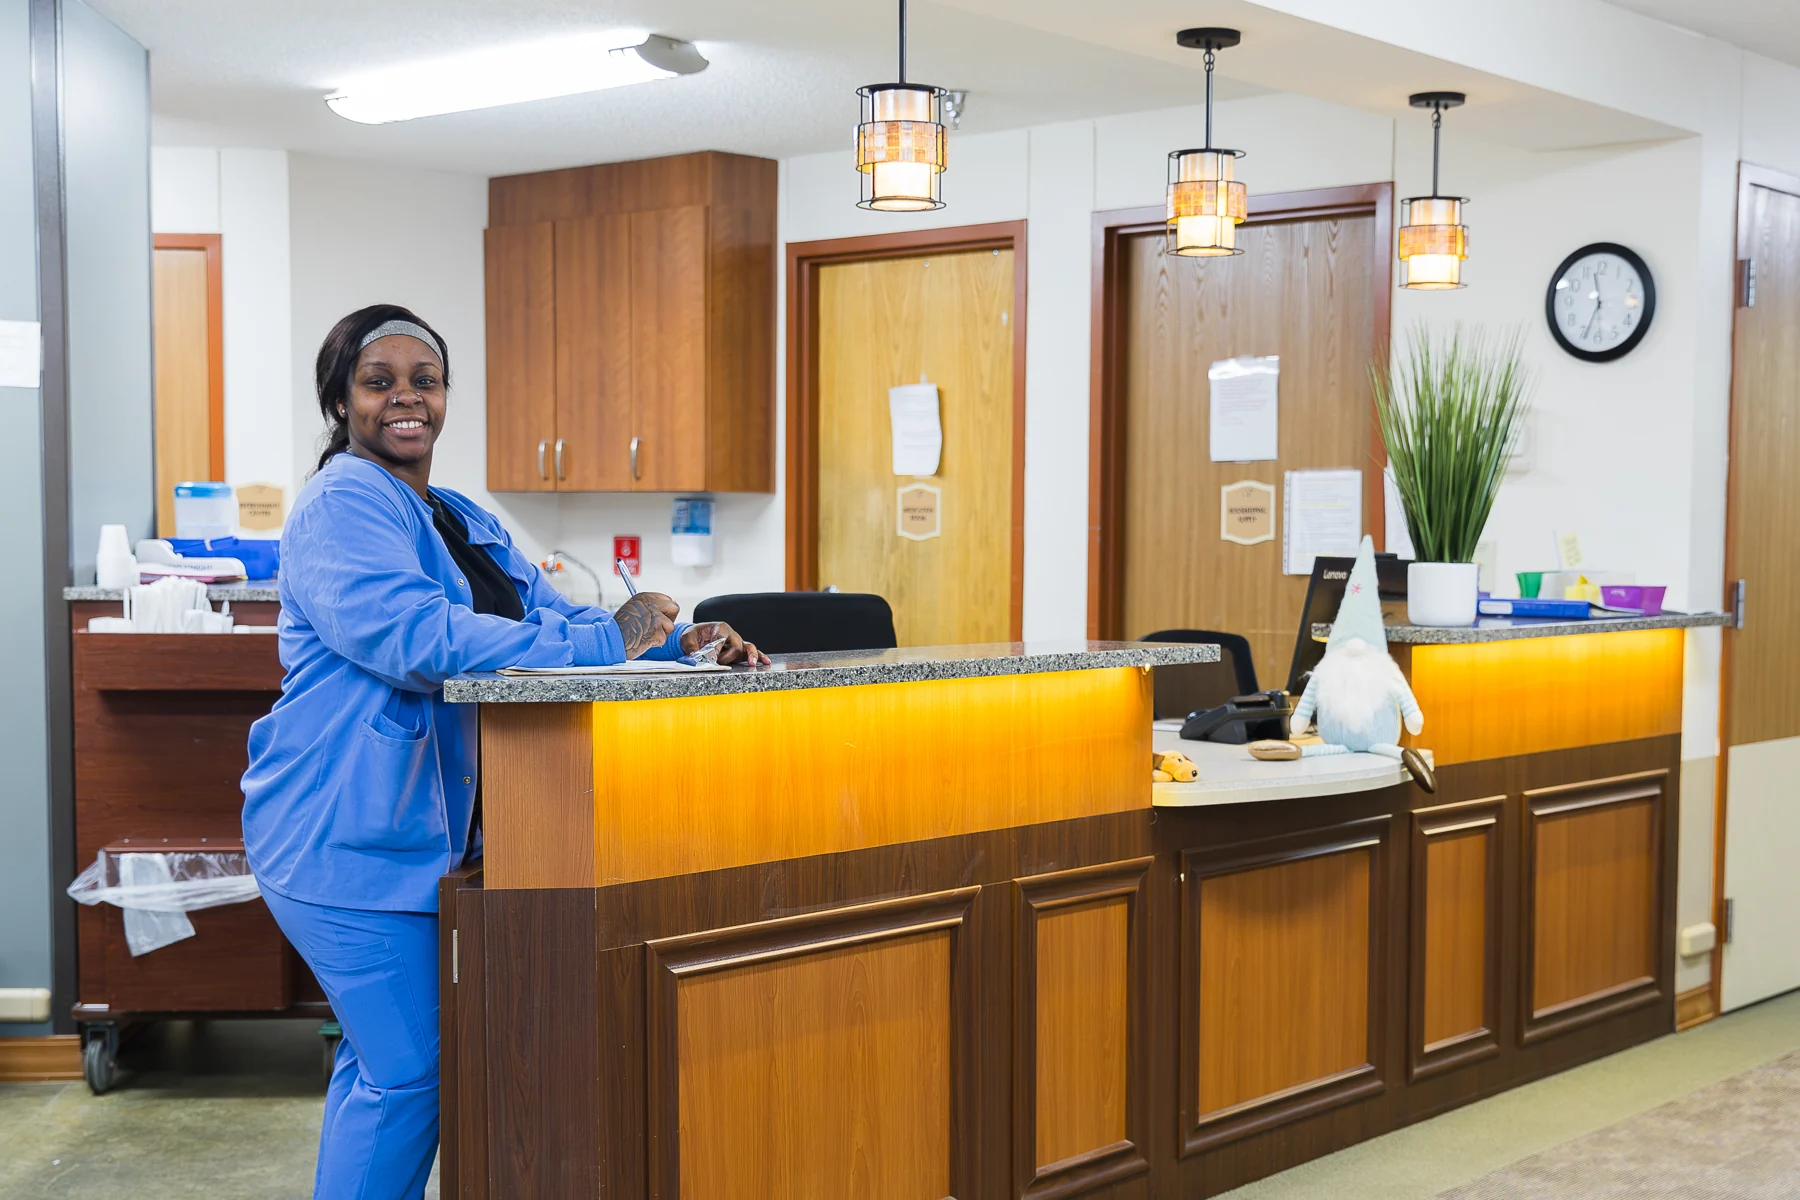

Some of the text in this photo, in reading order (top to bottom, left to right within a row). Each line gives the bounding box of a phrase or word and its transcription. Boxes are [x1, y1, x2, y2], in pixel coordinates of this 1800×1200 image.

[1582, 265, 1590, 280] 11
[1597, 261, 1607, 276] 12
[1568, 277, 1581, 293] 10
[1626, 278, 1633, 293] 2
[1567, 313, 1576, 327] 8
[1622, 312, 1632, 328] 4
[1323, 568, 1348, 580] Lenovo
